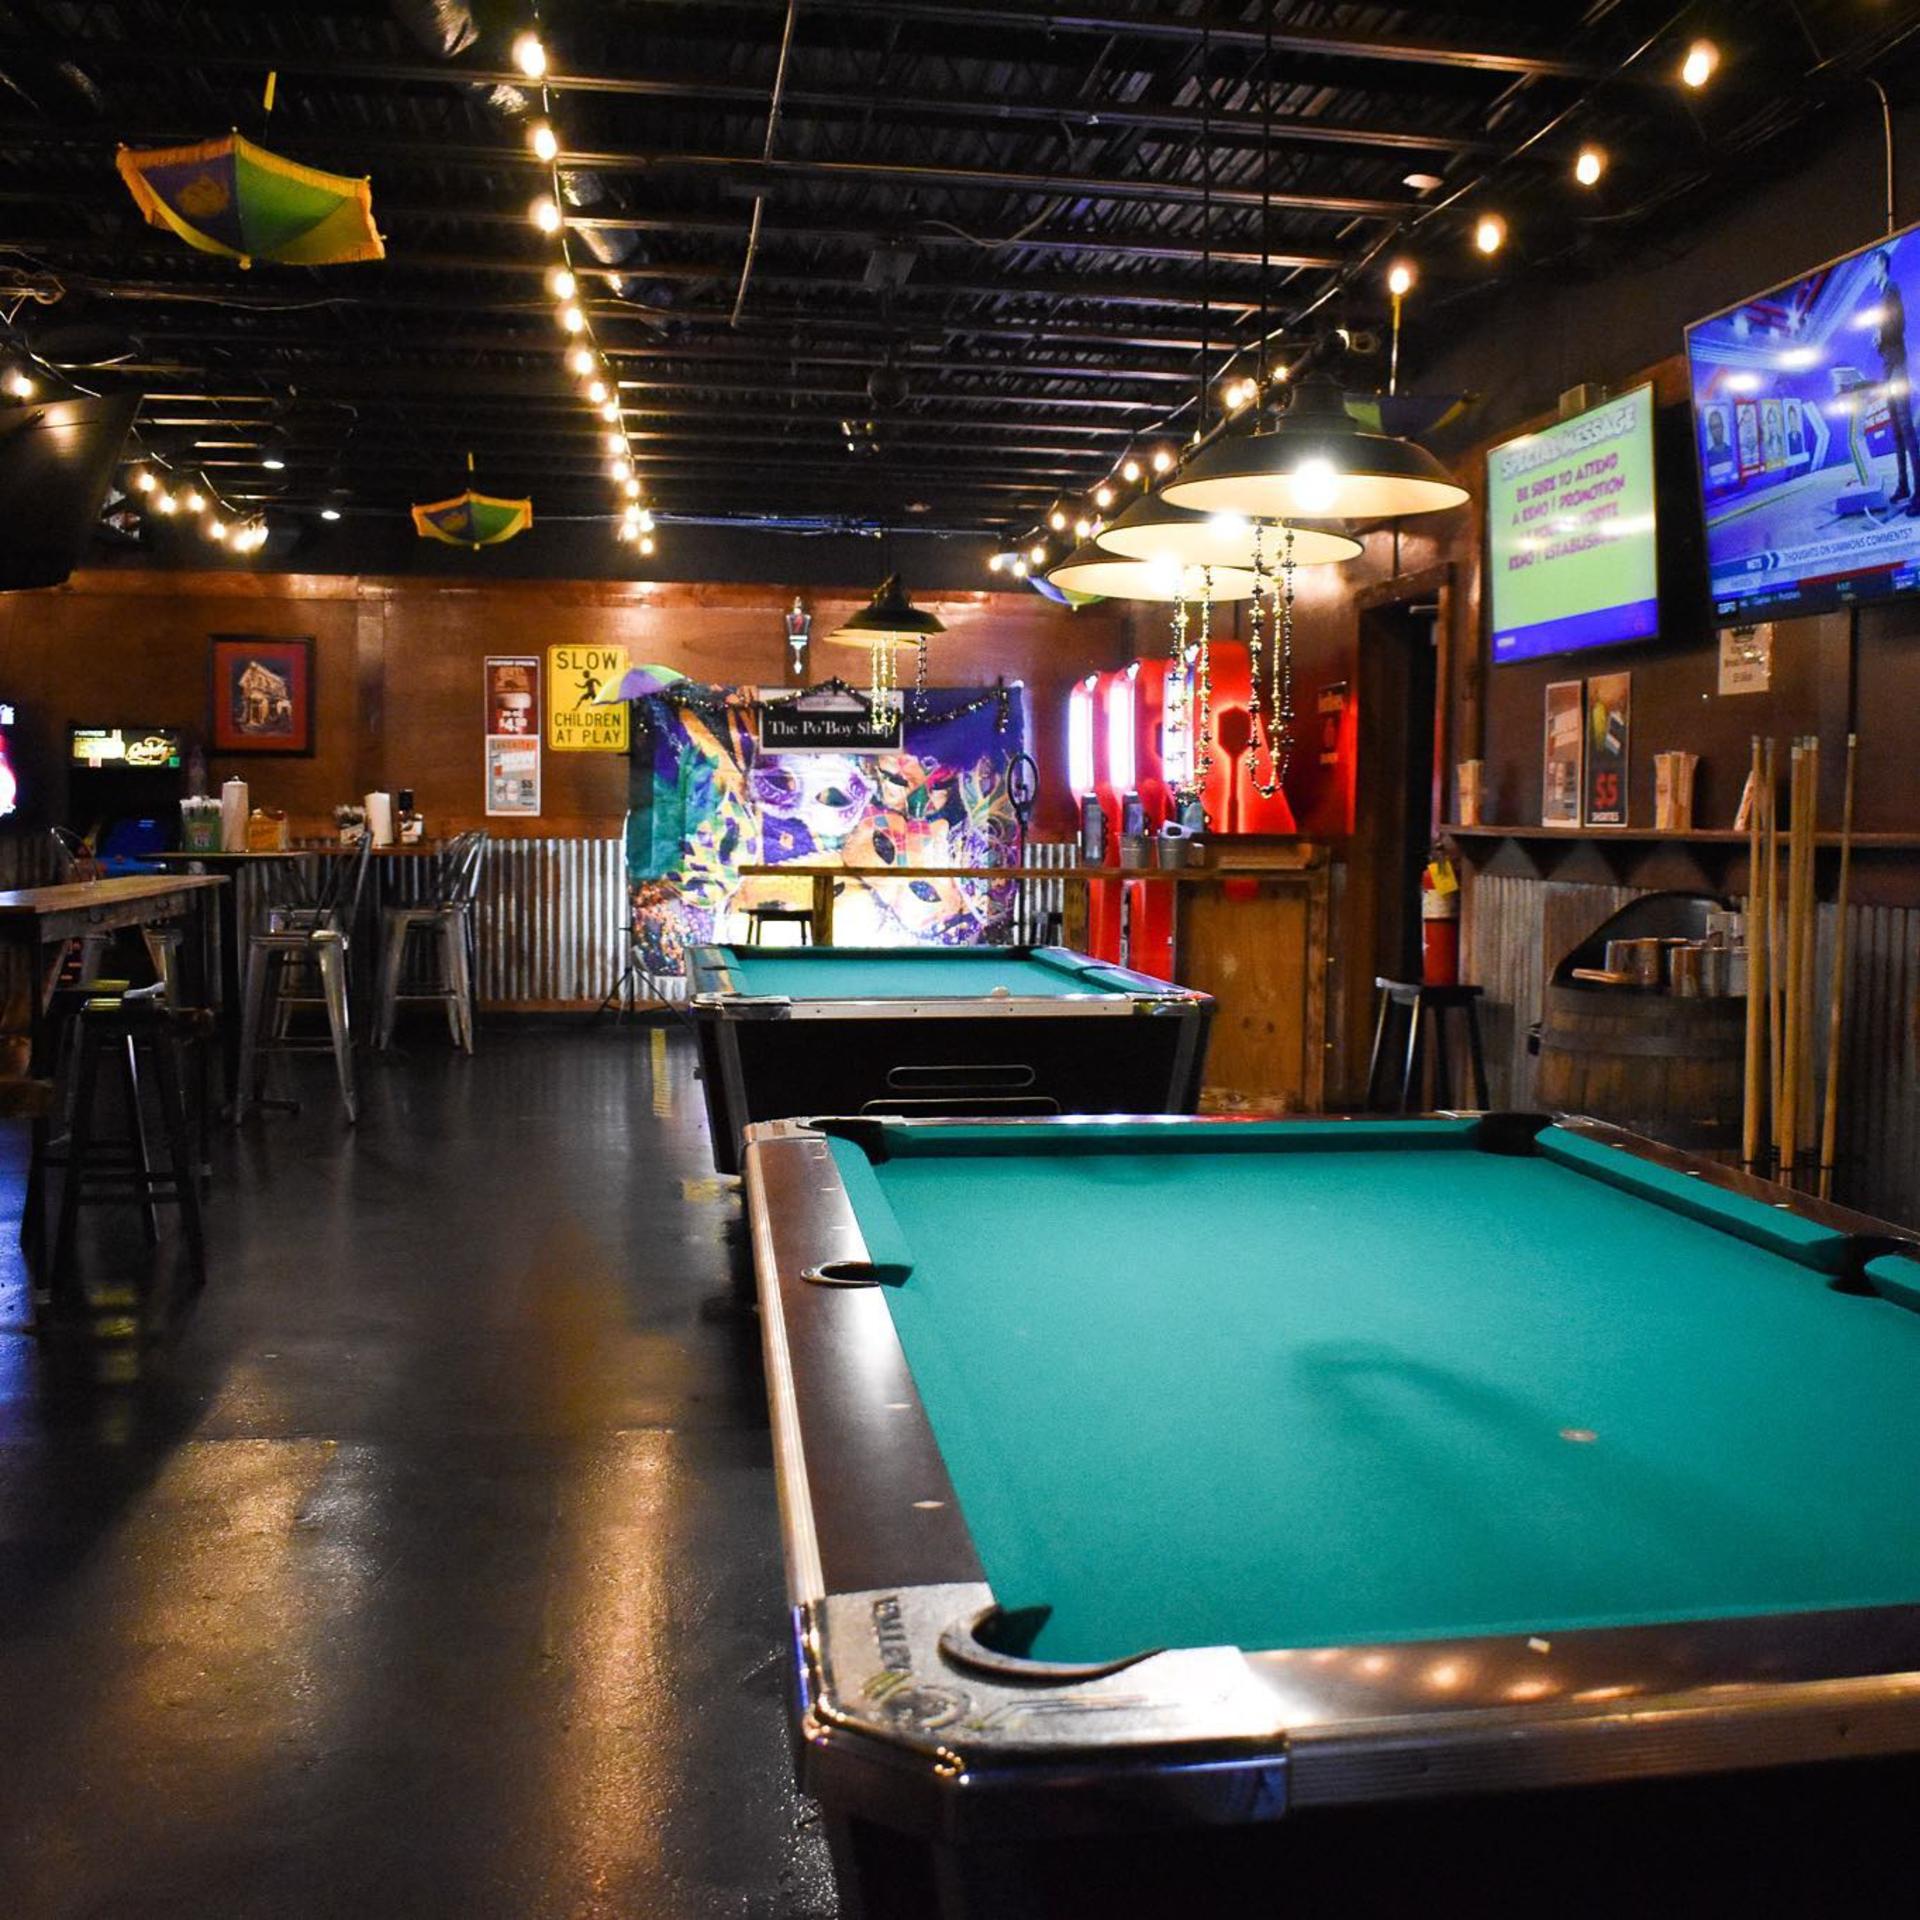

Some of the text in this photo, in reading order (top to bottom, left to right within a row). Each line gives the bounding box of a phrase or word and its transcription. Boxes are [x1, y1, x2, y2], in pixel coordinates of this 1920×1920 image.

[1560, 401, 1636, 458] MESSAGE
[1559, 468, 1572, 488] TO
[1575, 451, 1618, 482] ATTEND
[1559, 473, 1625, 510] PROMOTION
[556, 651, 617, 670] SLOW
[554, 712, 621, 727] CHILDREN
[769, 721, 798, 735] The
[555, 729, 621, 744] AT PLAY
